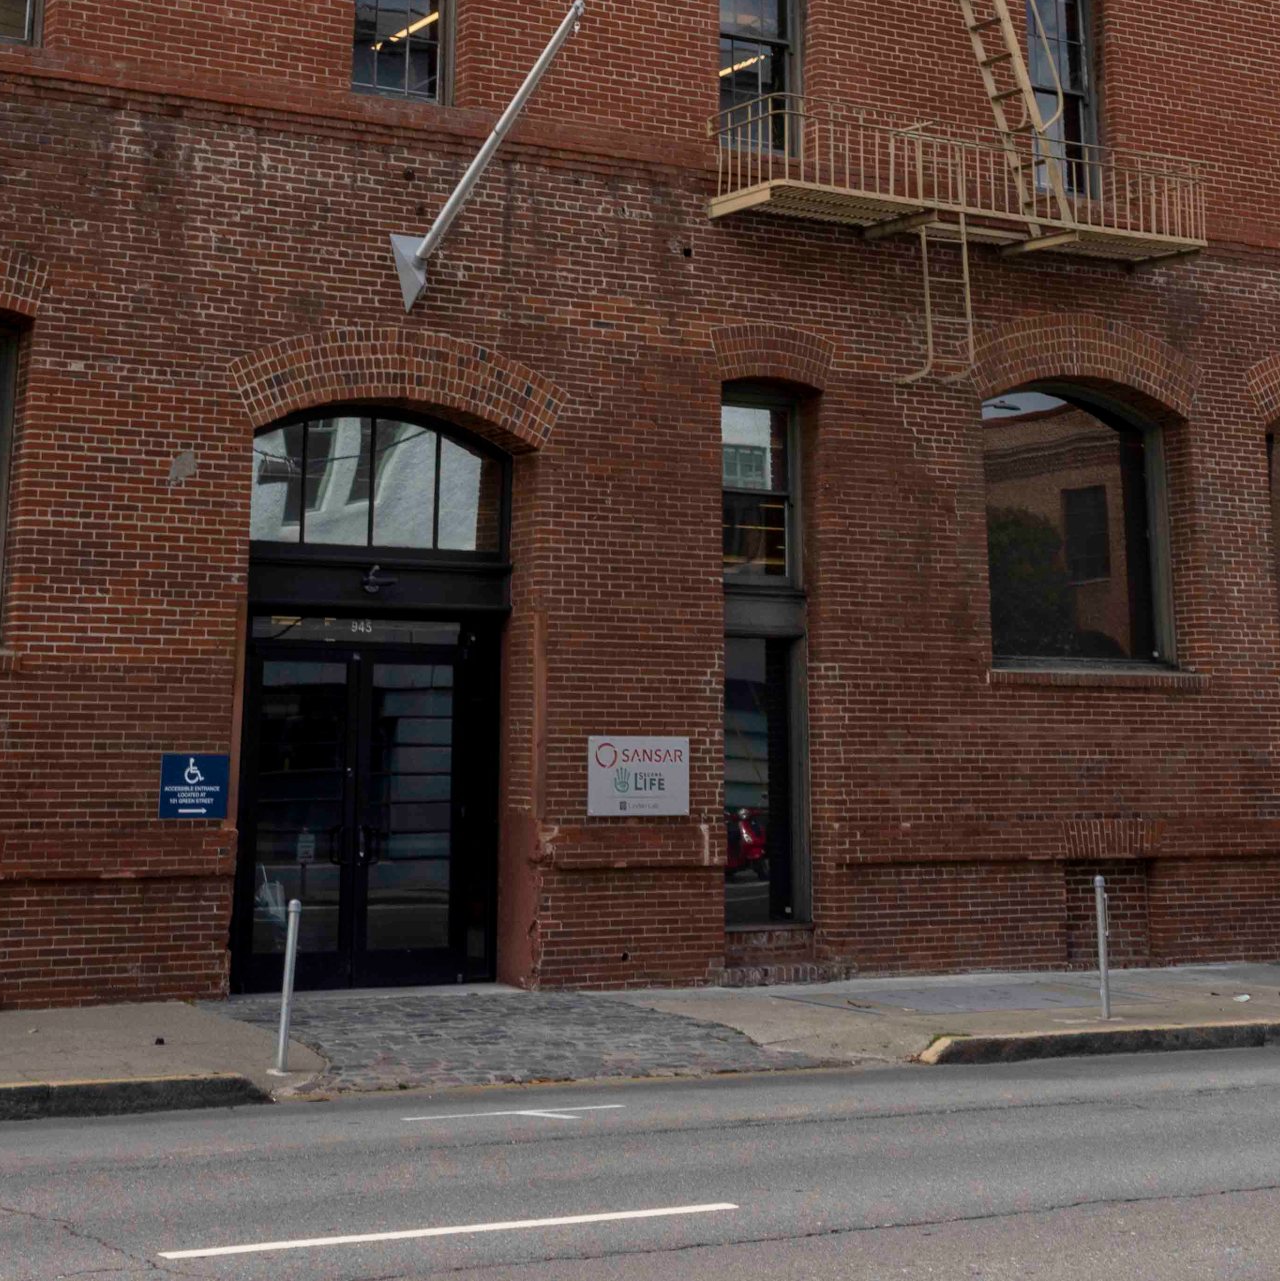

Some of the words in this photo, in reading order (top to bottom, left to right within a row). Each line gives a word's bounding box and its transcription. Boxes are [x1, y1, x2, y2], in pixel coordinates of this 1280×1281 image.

[352, 621, 372, 632] 945
[622, 748, 683, 763] SANSAR
[634, 772, 665, 791] LIFE
